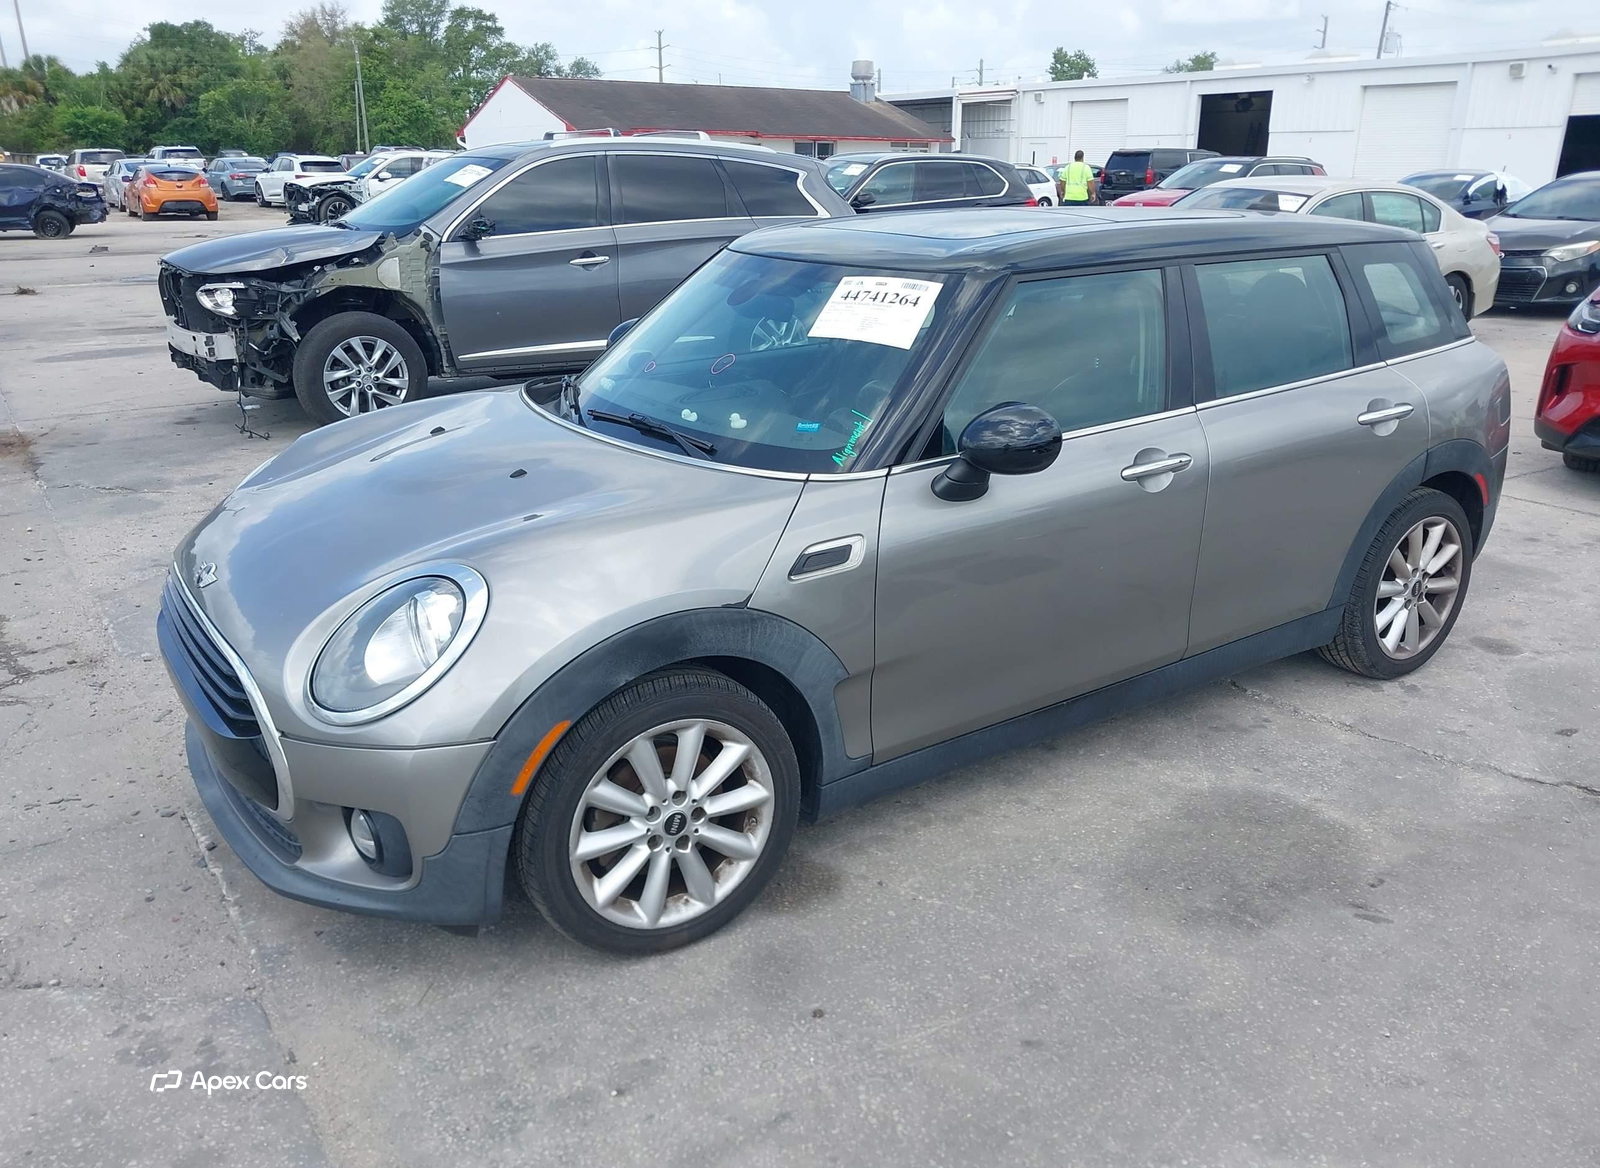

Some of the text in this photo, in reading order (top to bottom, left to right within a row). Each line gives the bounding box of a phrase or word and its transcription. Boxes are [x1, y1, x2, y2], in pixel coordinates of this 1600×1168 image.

[841, 289, 921, 307] 44741264
[831, 421, 865, 467] Alignment
[669, 814, 682, 834] MINI
